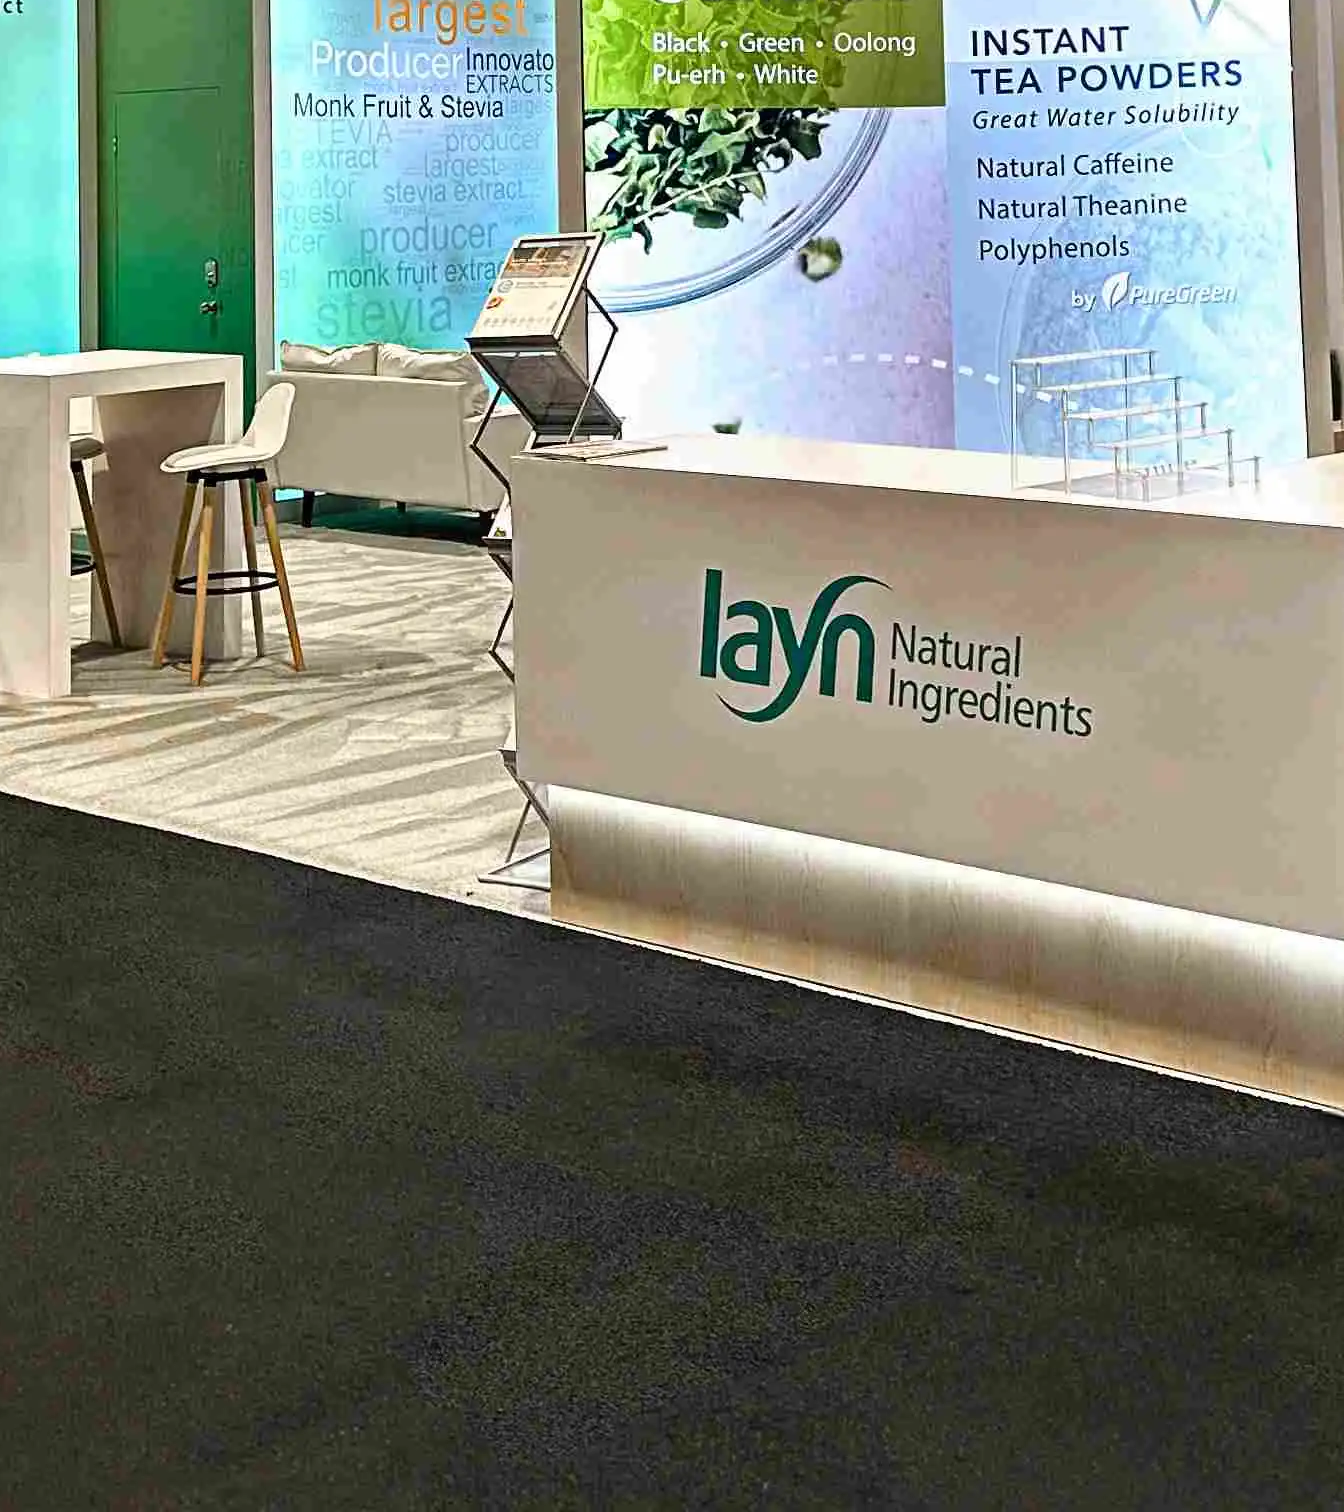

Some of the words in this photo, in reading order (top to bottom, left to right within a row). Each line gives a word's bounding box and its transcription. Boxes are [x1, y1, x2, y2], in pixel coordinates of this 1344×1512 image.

[652, 31, 710, 54] Black
[738, 32, 805, 54] Green
[833, 31, 916, 58] Oolong
[971, 25, 1130, 57] INSTANT
[311, 40, 464, 80] Producer
[652, 63, 726, 85] Pu-erh
[753, 63, 819, 85] White
[466, 74, 554, 95] EXTRACTS
[971, 65, 1043, 96] TEA
[1058, 59, 1243, 92] POWDERS
[294, 92, 355, 119] Monk
[363, 94, 414, 119] Fruit
[419, 95, 434, 119] &
[440, 93, 504, 120] Stevia
[972, 107, 1040, 130] Great
[1047, 105, 1117, 128] Water
[1124, 101, 1240, 130] Solubility
[446, 131, 541, 152] producer
[425, 151, 500, 180] largest
[976, 153, 1066, 180] Natural
[1073, 150, 1175, 176] Caffeine
[383, 180, 446, 206] stevia
[457, 179, 523, 203] extract
[977, 193, 1067, 220] Natural
[1073, 190, 1188, 217] Theanine
[361, 217, 498, 258] producer
[979, 233, 1130, 263] Polyphenols
[328, 259, 390, 289] monk
[397, 260, 438, 286] fruit
[1071, 290, 1096, 313] by
[1130, 284, 1237, 306] PureGreen
[316, 293, 453, 340] stevia
[700, 568, 894, 723] layn
[891, 622, 1022, 678] Natural
[888, 668, 1093, 738] Ingredients
